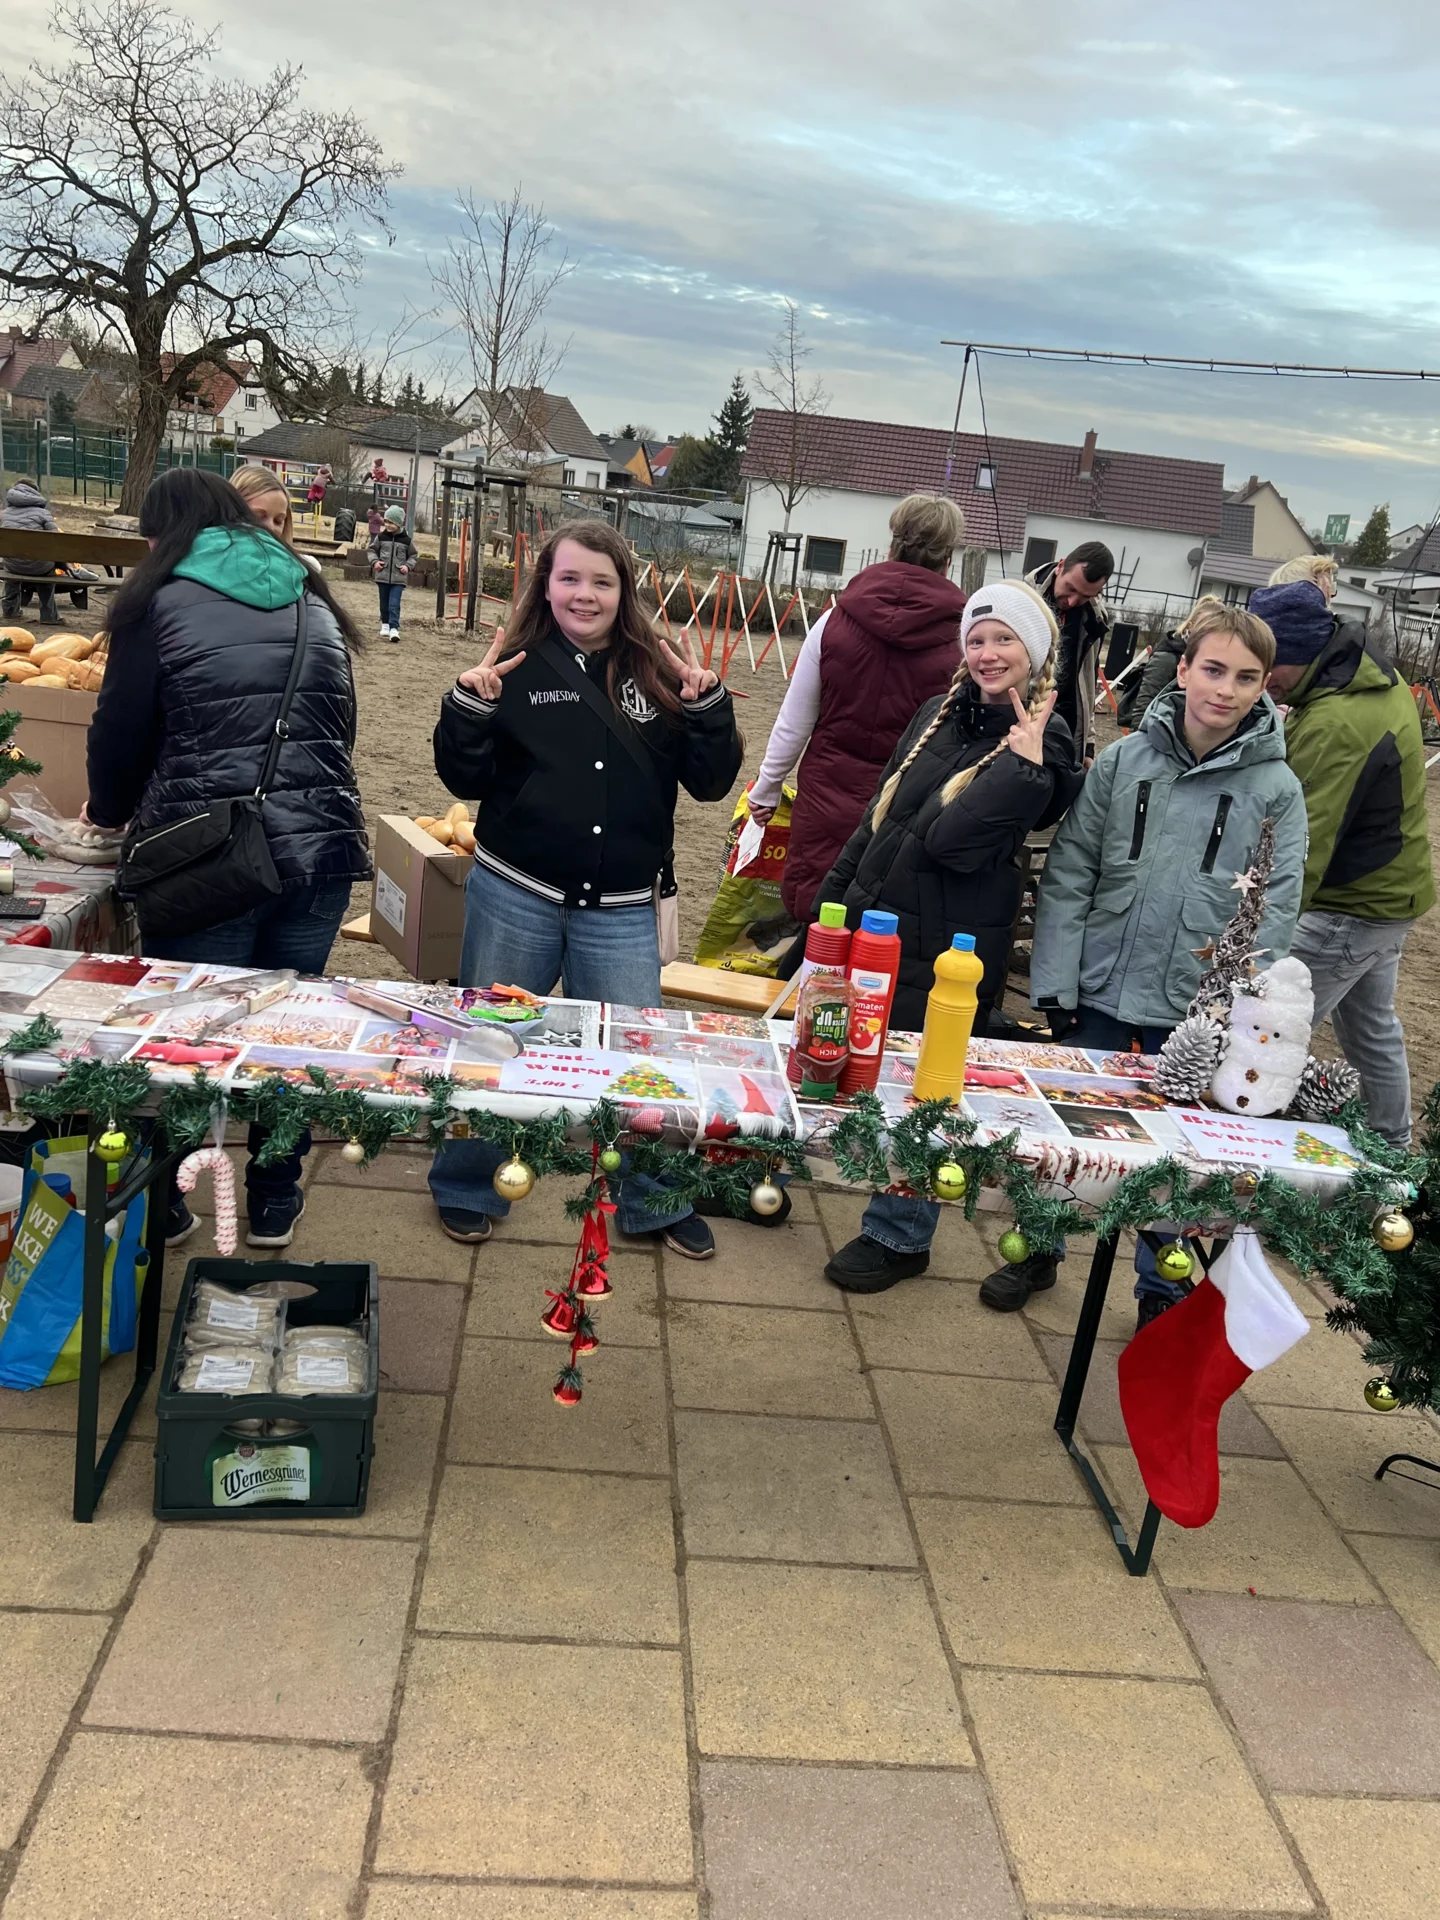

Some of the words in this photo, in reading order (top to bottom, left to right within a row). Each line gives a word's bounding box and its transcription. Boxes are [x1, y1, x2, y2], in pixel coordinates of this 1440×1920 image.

[529, 690, 580, 706] WEDNESDAY
[763, 845, 786, 860] SO
[854, 1002, 884, 1011] omaten
[525, 1063, 613, 1077] wurst
[1180, 1114, 1256, 1130] Brat-
[1201, 1131, 1286, 1147] wurst
[28, 1202, 58, 1239] WE
[220, 1464, 305, 1497] Wernesgrüner
